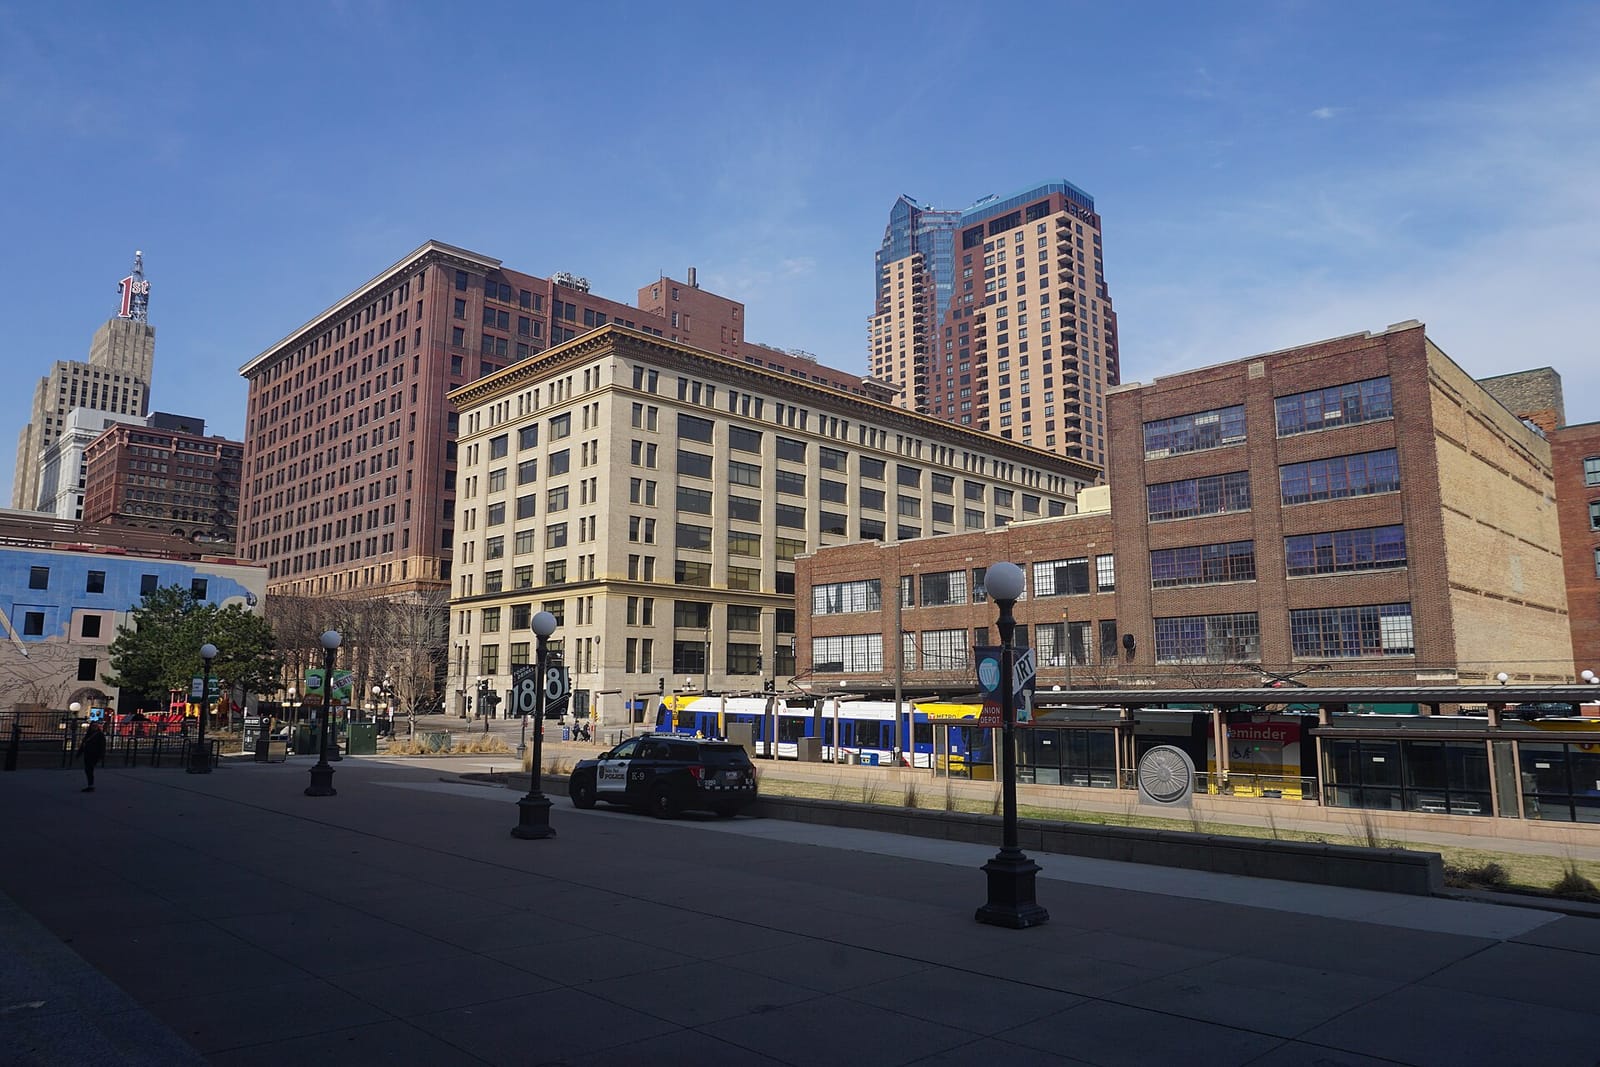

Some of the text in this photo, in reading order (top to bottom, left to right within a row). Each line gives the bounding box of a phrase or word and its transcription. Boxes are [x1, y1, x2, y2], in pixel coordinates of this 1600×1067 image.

[982, 706, 1001, 715] NION
[980, 716, 1001, 724] DEPOT
[1228, 727, 1287, 740] eminder
[631, 771, 645, 780] K-9
